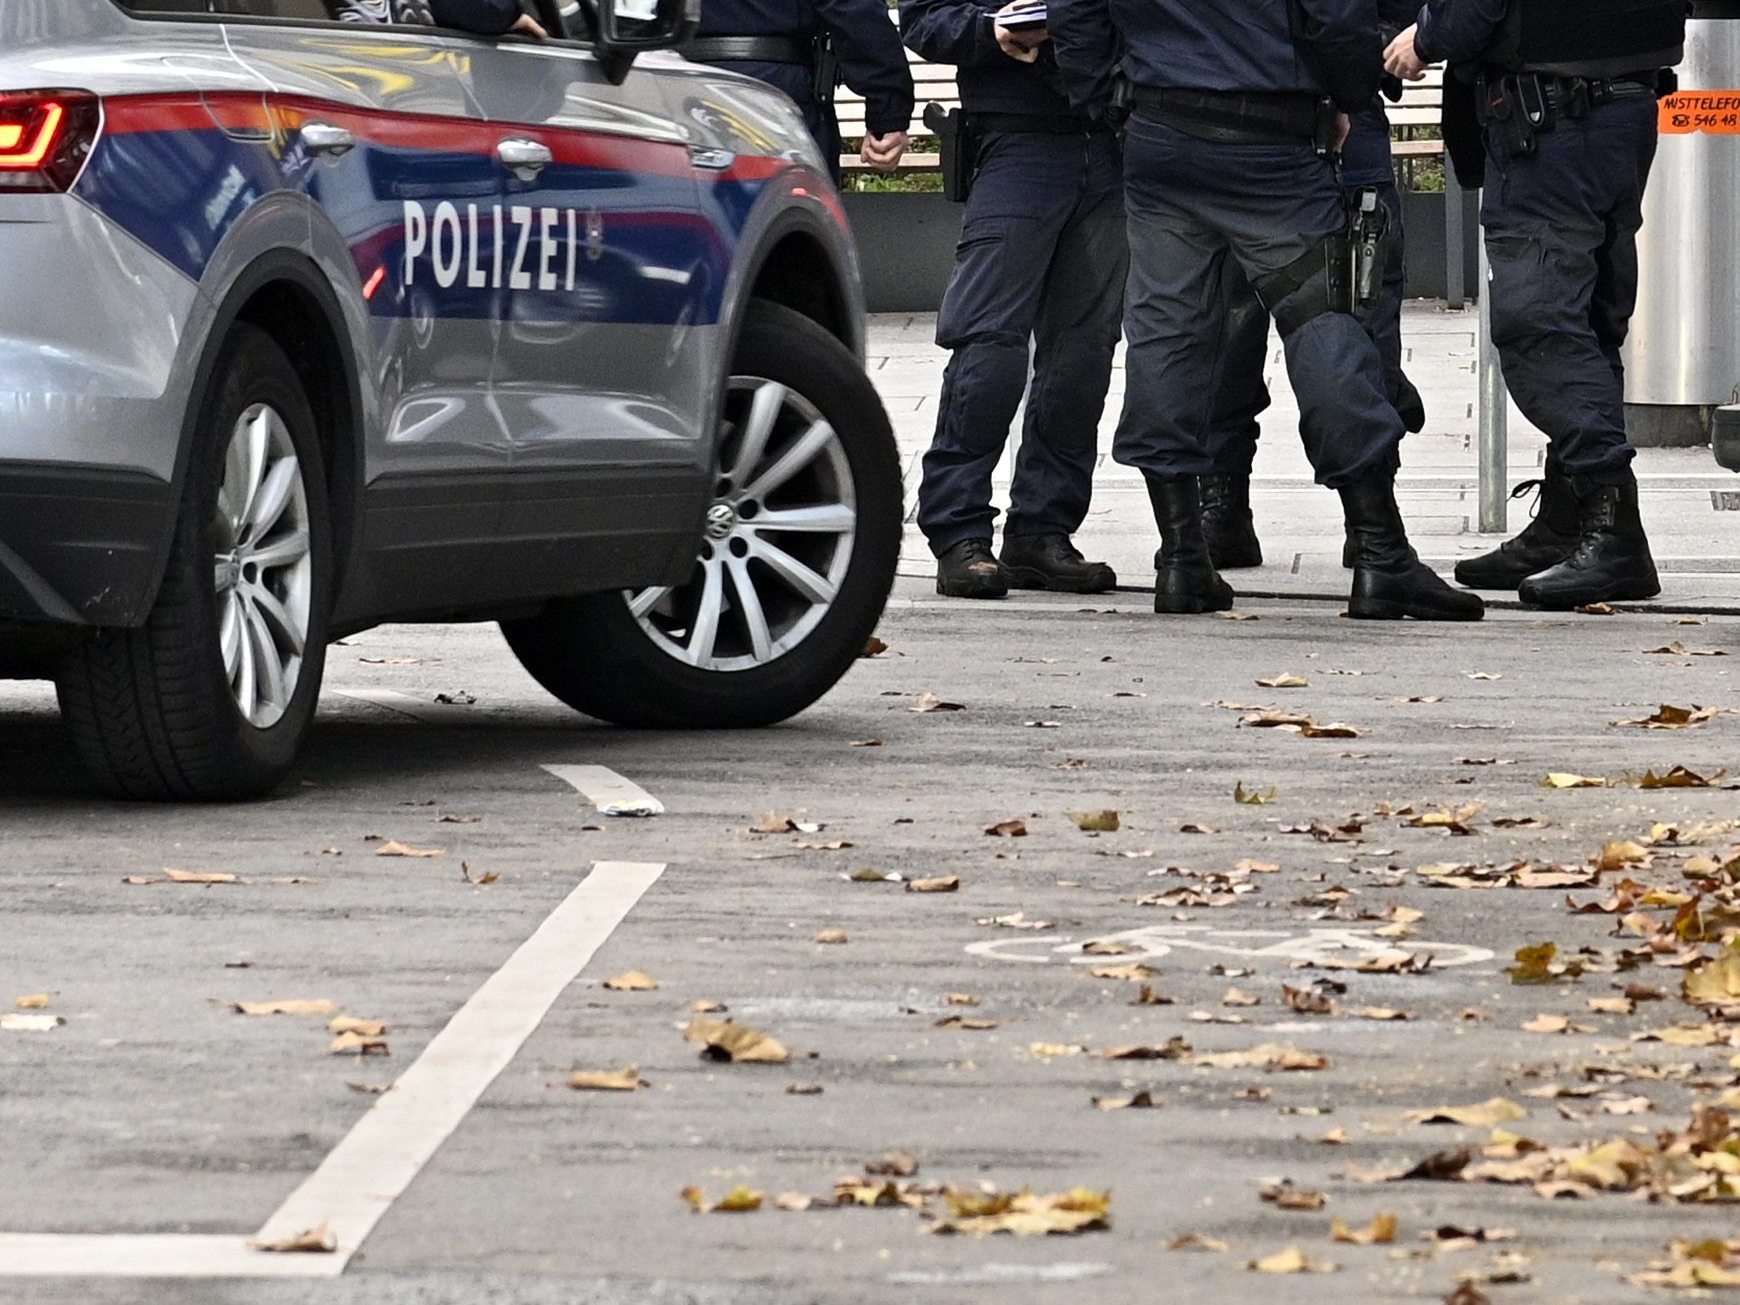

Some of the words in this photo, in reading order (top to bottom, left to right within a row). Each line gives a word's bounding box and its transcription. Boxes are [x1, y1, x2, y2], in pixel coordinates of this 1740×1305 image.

[1694, 114, 1718, 127] 546
[1721, 114, 1738, 126] 48
[403, 200, 576, 291] POLIZEI
